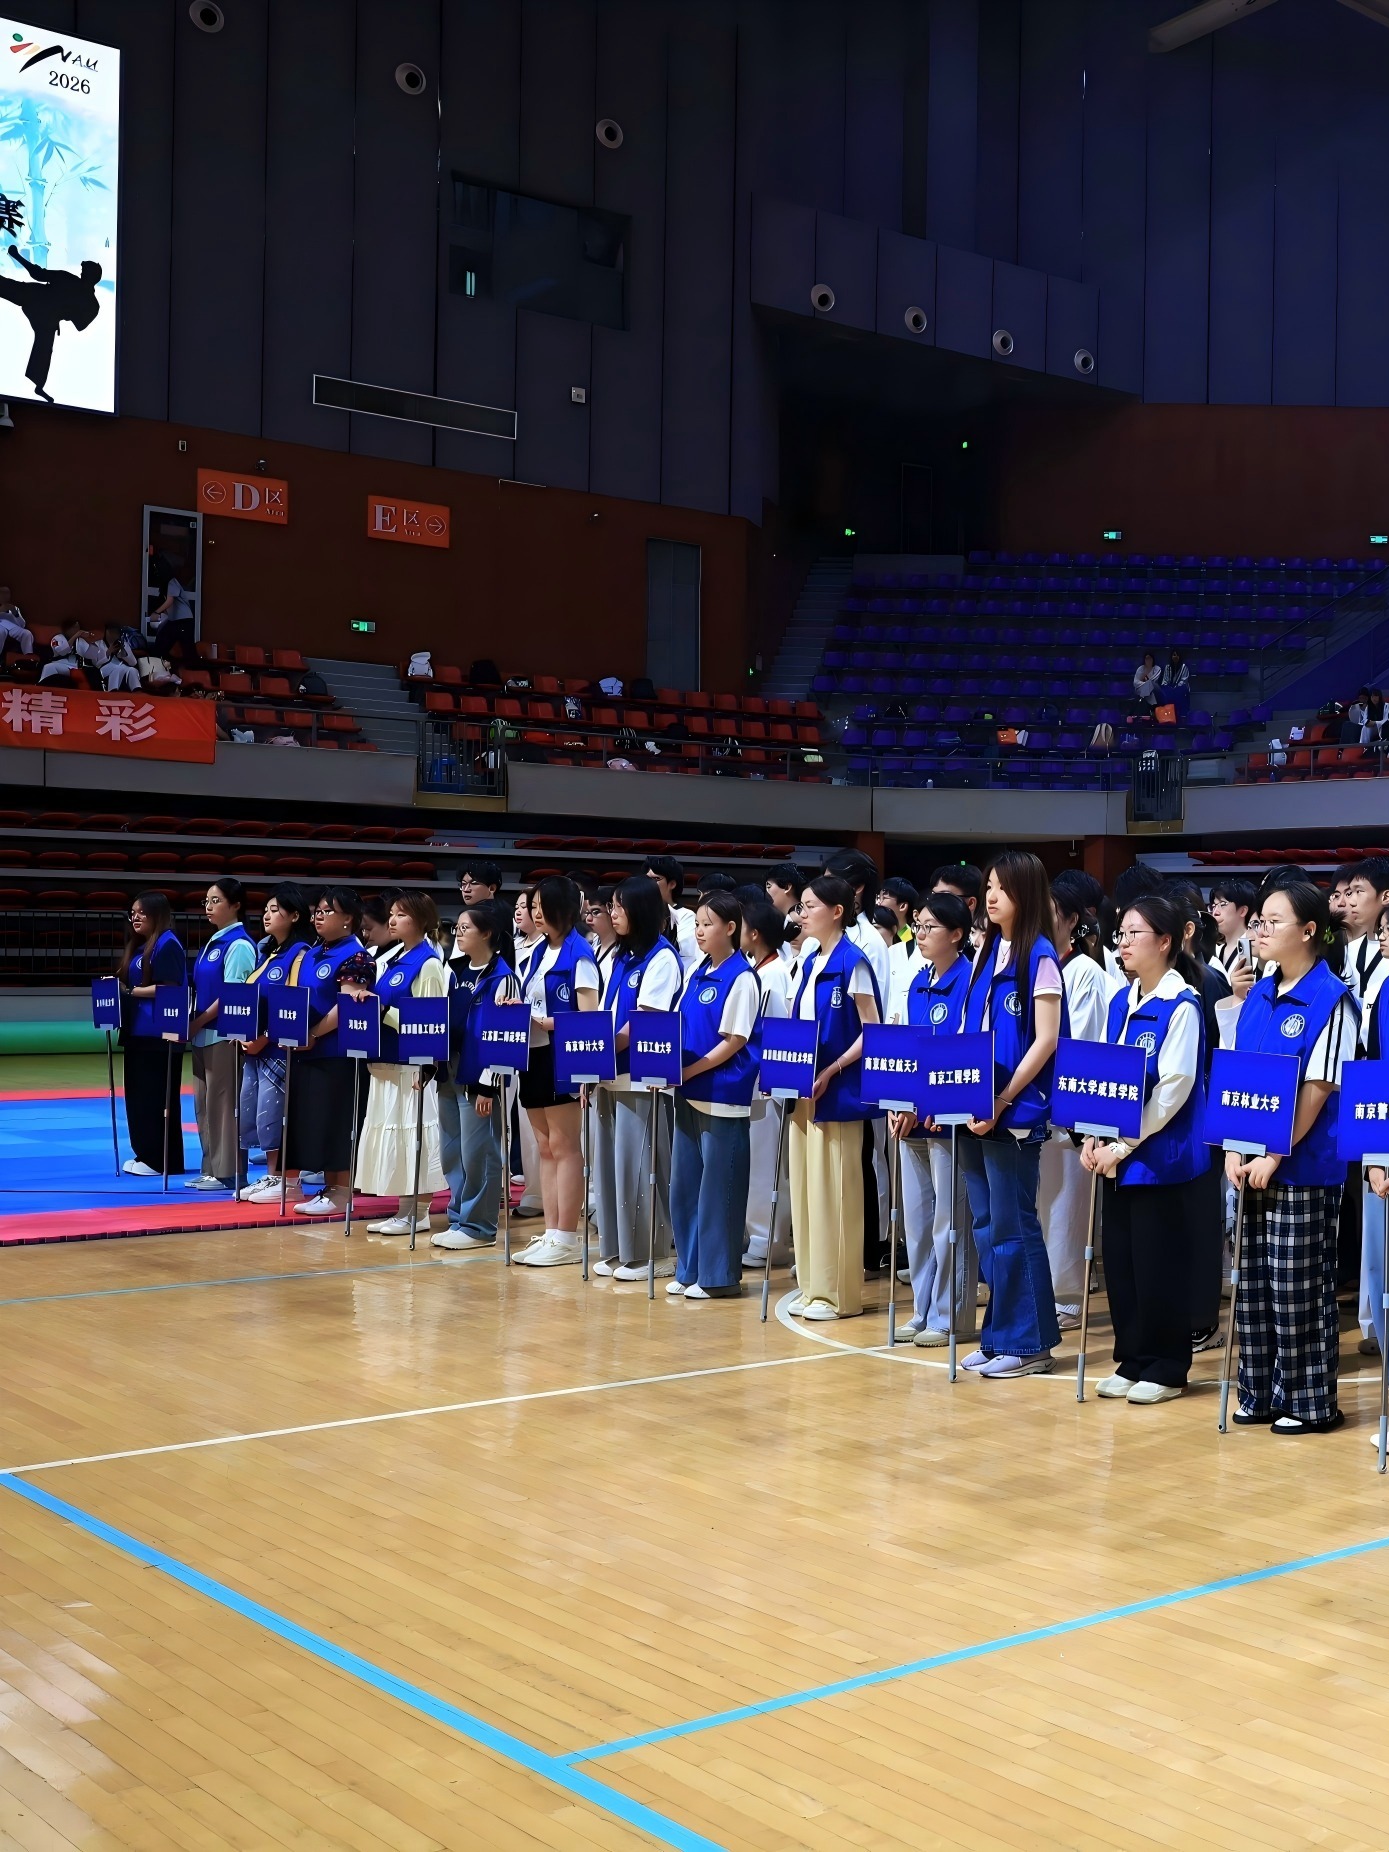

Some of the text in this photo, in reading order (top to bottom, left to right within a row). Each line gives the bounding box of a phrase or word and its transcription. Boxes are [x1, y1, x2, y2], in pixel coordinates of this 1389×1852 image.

[48, 70, 91, 95] 2026
[231, 481, 284, 511] D区
[373, 504, 420, 533] E区
[1, 688, 157, 743] 精彩
[929, 1068, 980, 1085] 南京工程学院
[1058, 1075, 1139, 1101] 东南大学成贤学院
[1221, 1089, 1280, 1112] 南京林业大学
